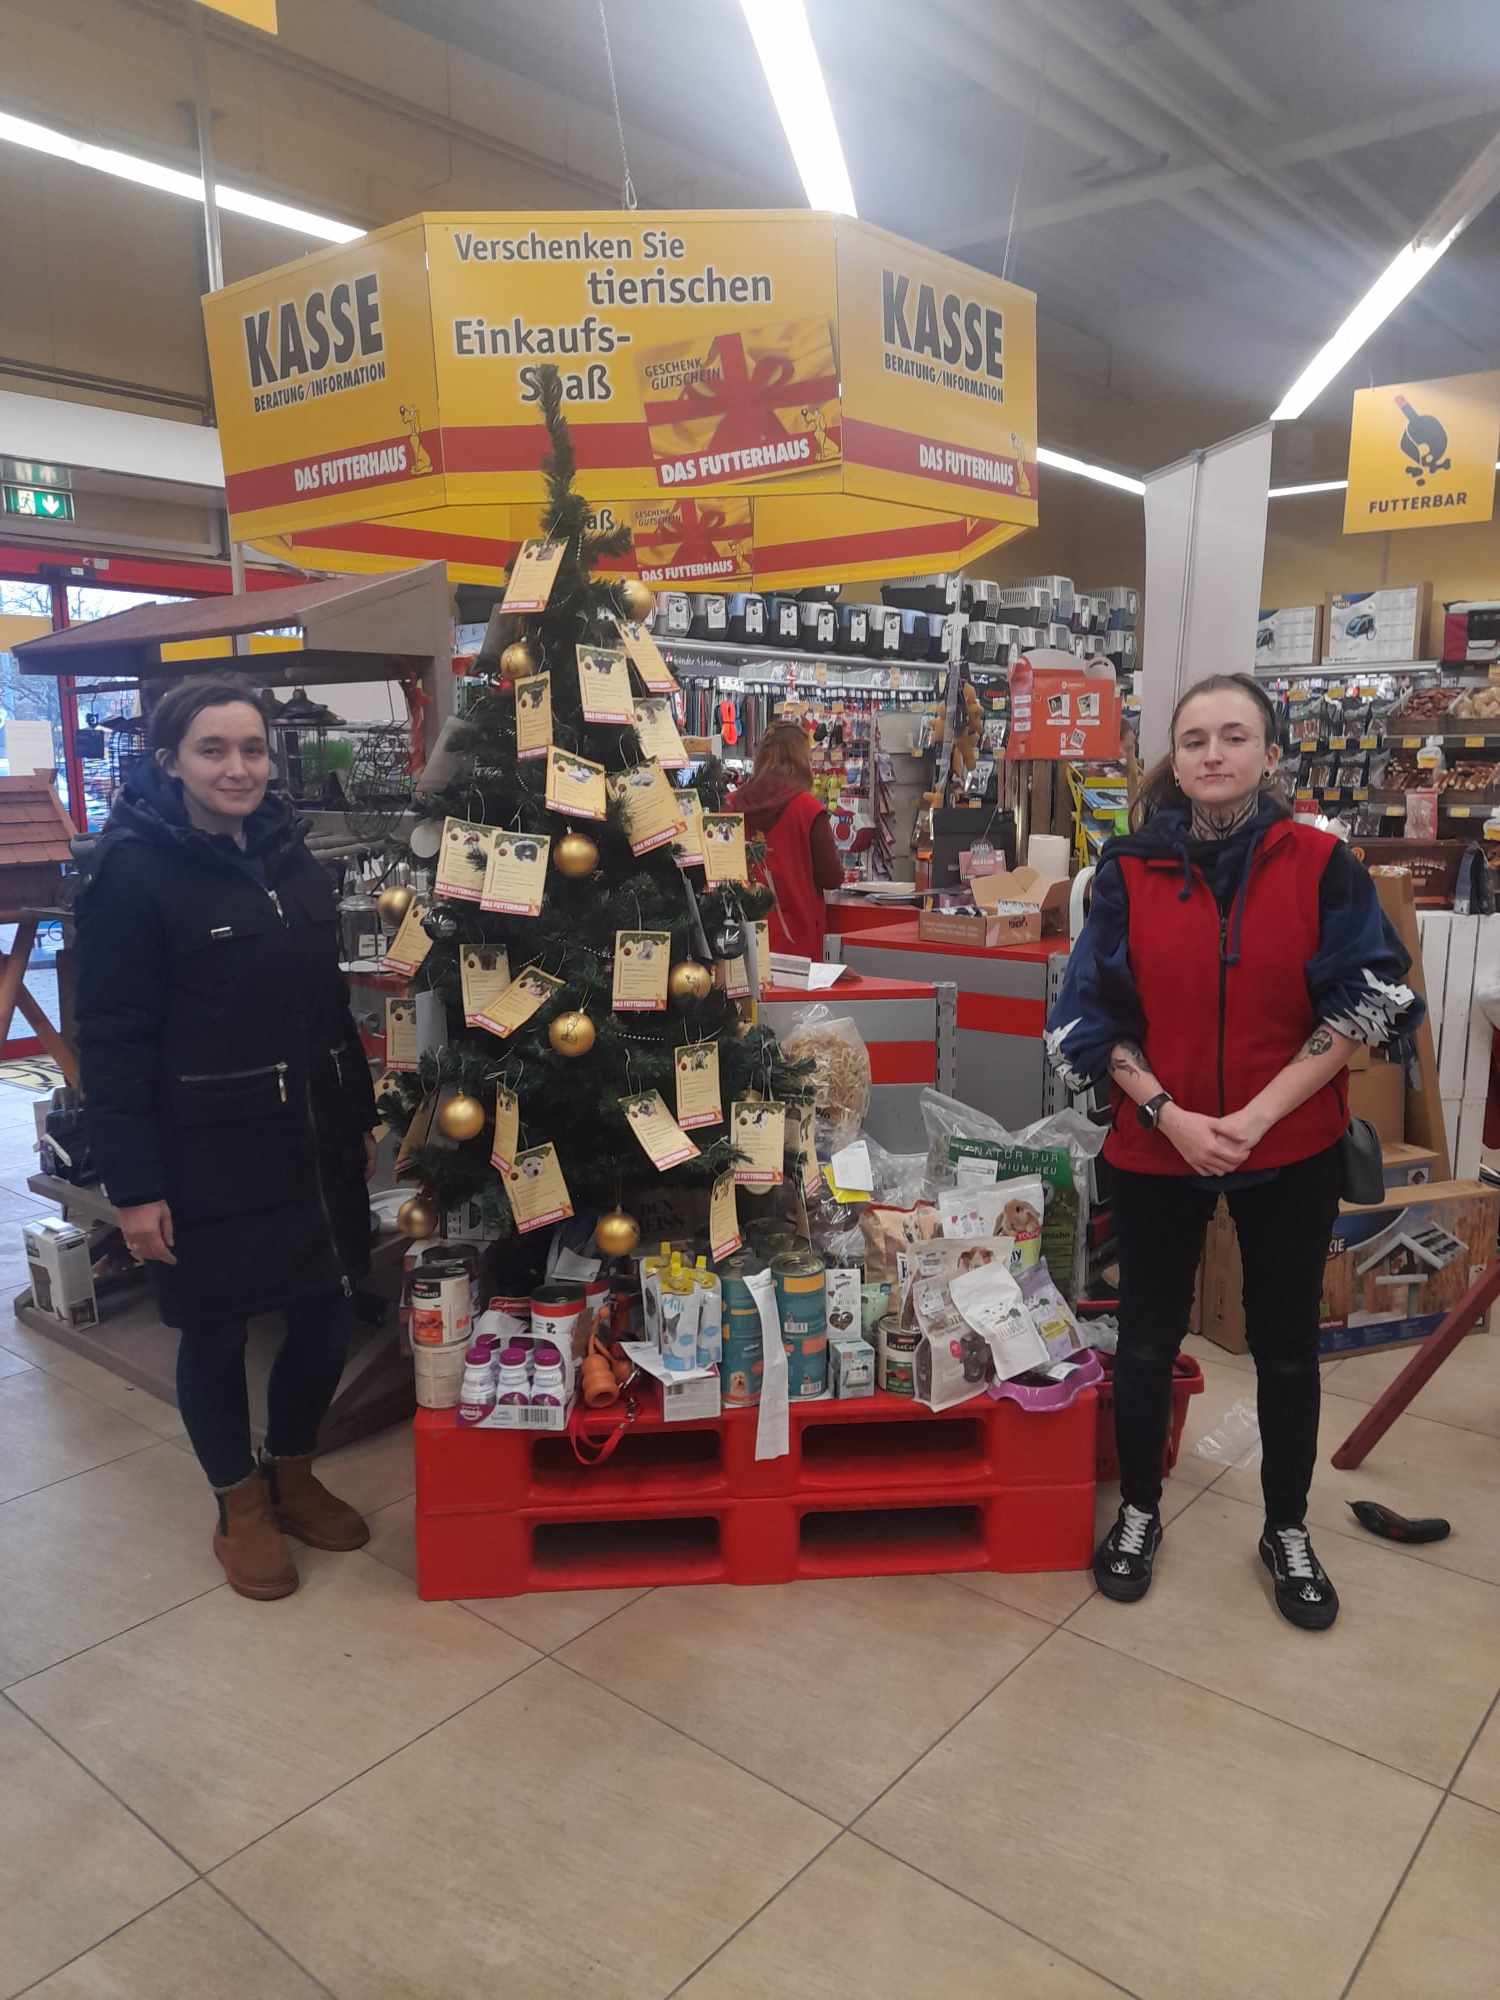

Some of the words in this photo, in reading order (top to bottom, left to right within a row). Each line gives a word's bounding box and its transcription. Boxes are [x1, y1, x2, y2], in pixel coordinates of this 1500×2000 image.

[454, 231, 632, 261] Verschenken
[643, 231, 685, 259] Sie
[587, 268, 772, 306] tierischen
[243, 273, 385, 389] KASSE
[455, 317, 632, 355] Einkaufs-
[882, 269, 1003, 380] KASSE
[253, 361, 386, 413] BERATUNG/INFORMATION
[519, 364, 612, 402] Saß
[884, 352, 1004, 404] BERATUNG/INFORMATION
[294, 461, 321, 492] DAS
[321, 445, 407, 488] FUTTERHAUS
[661, 455, 697, 484] DAS
[698, 438, 810, 477] FUTTERHAUS
[919, 444, 943, 472] DAS
[944, 450, 1014, 487] FUTTERHAUS
[1368, 491, 1468, 515] FUTTERBAR
[641, 569, 664, 581] DAS
[665, 559, 734, 580] FUTTERHAUS
[974, 1146, 1023, 1161] NATUR
[1032, 1152, 1059, 1163] PUR
